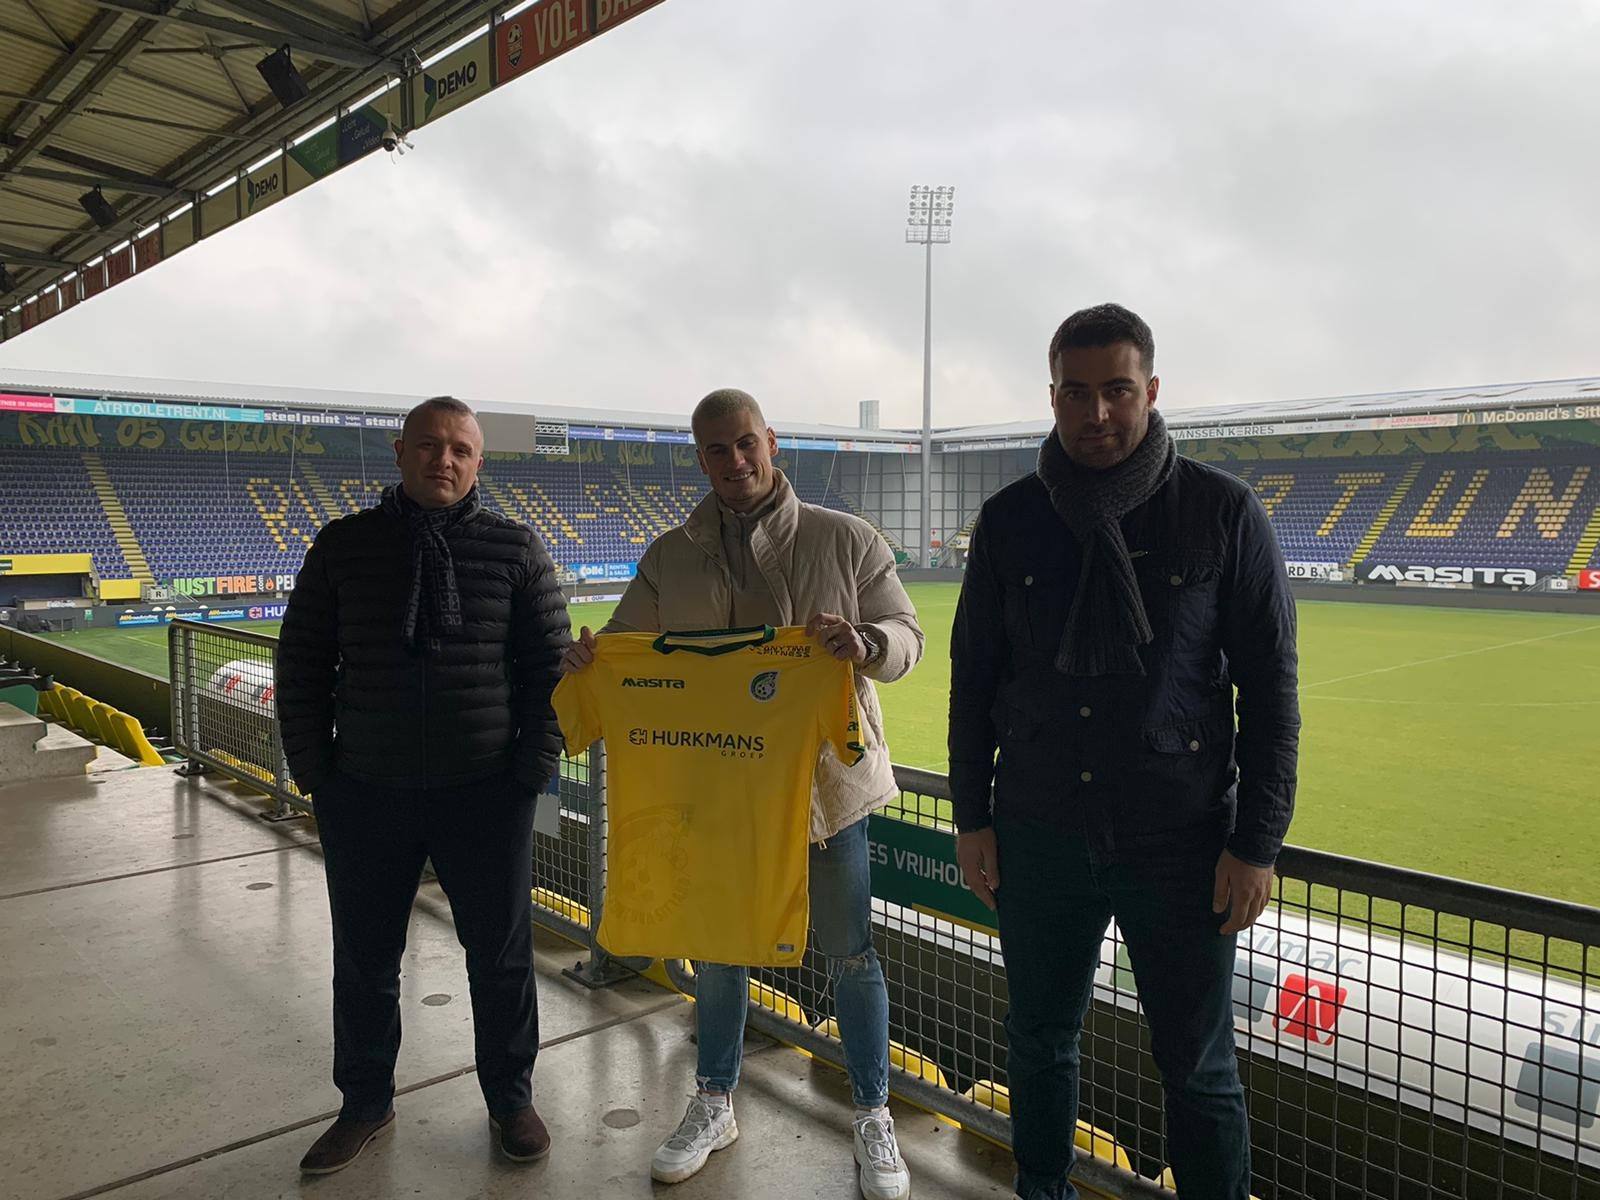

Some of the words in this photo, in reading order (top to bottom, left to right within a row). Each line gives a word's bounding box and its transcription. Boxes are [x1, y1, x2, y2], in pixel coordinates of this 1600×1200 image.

[438, 61, 477, 100] DEMO
[255, 173, 278, 199] DEMO
[94, 401, 231, 419] ATRTOILETRENT.NL
[1482, 405, 1570, 424] McDonald's
[1173, 428, 1224, 439] JANSSEN
[1228, 425, 1275, 436] KERRES
[173, 577, 216, 596] JUST
[216, 575, 257, 594] FIRE
[652, 730, 765, 752] HURKMANS
[721, 750, 764, 759] GROEP
